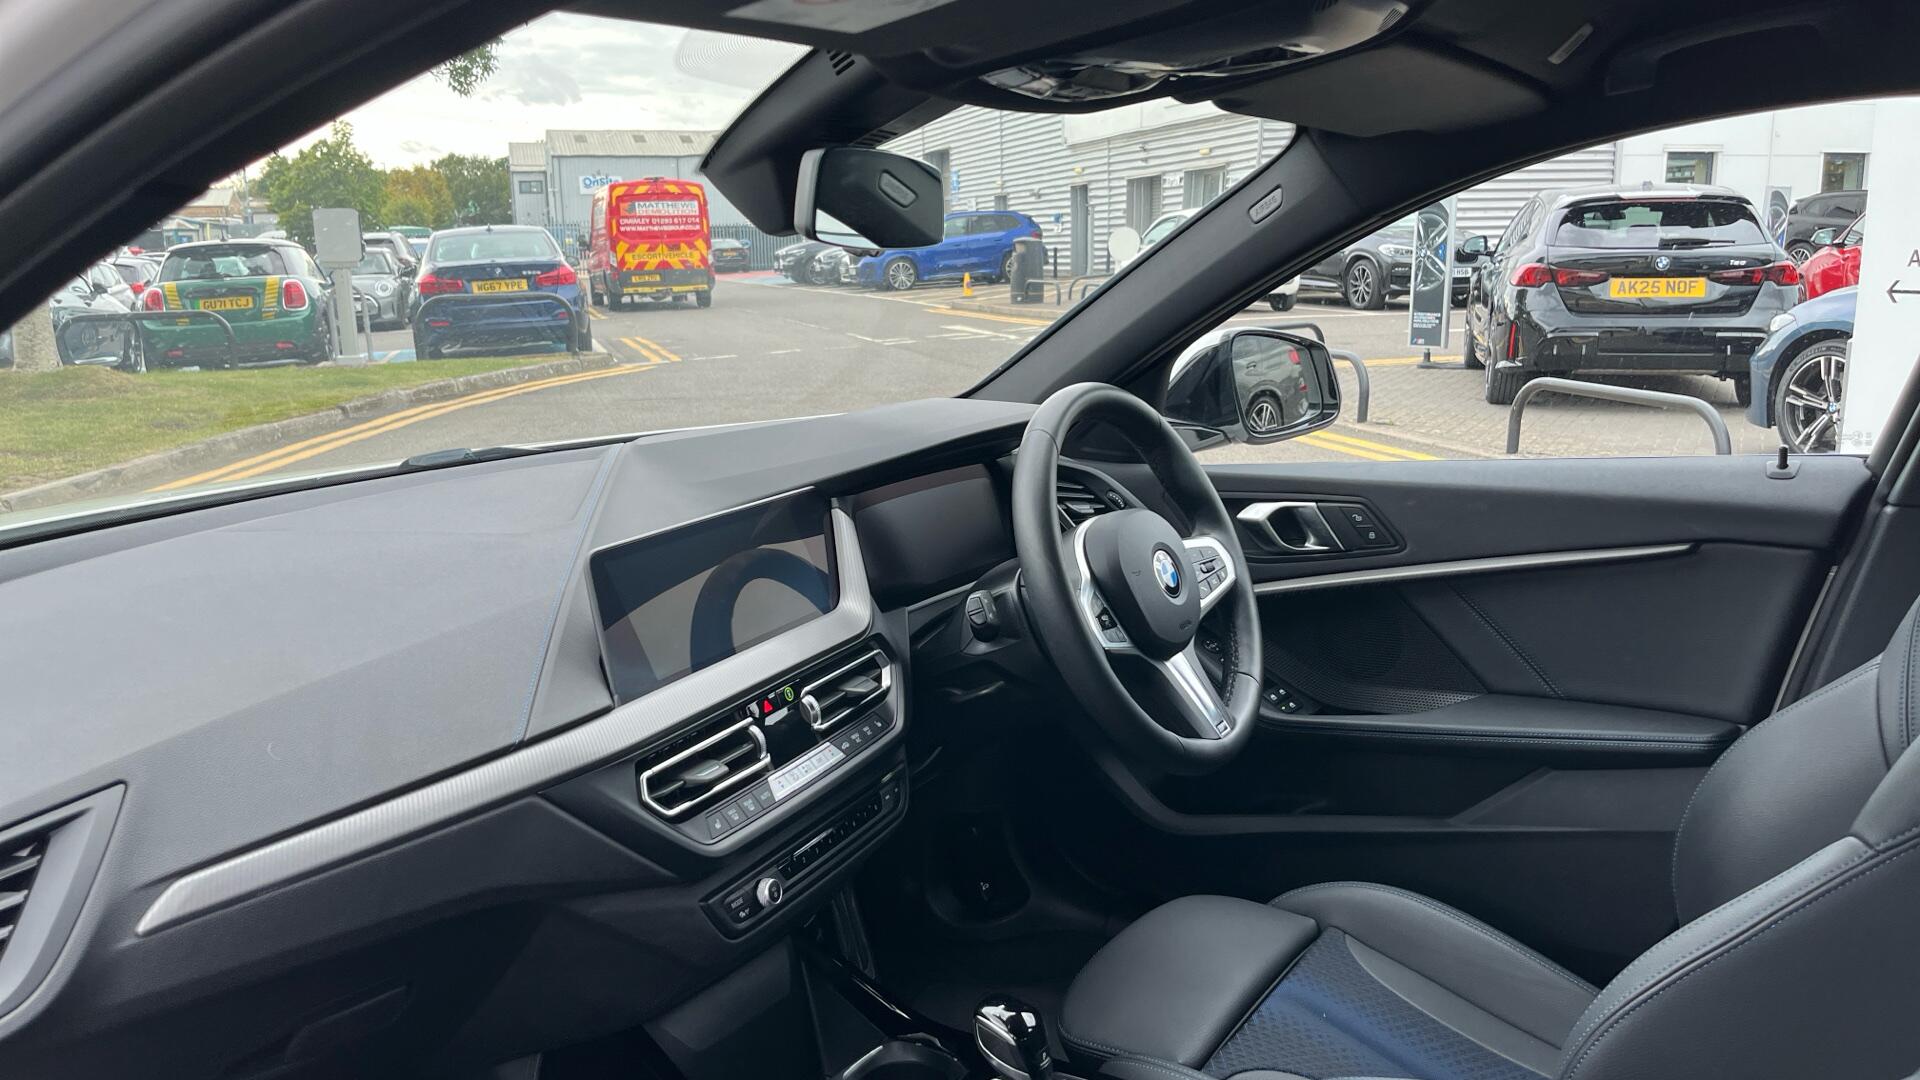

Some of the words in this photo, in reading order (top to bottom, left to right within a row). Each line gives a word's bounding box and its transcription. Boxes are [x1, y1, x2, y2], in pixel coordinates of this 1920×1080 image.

[632, 252, 661, 260] ESCORT
[663, 251, 695, 259] VEHICLE
[504, 280, 524, 290] YPE
[1617, 279, 1661, 295] AK25
[1665, 279, 1699, 294] NOF
